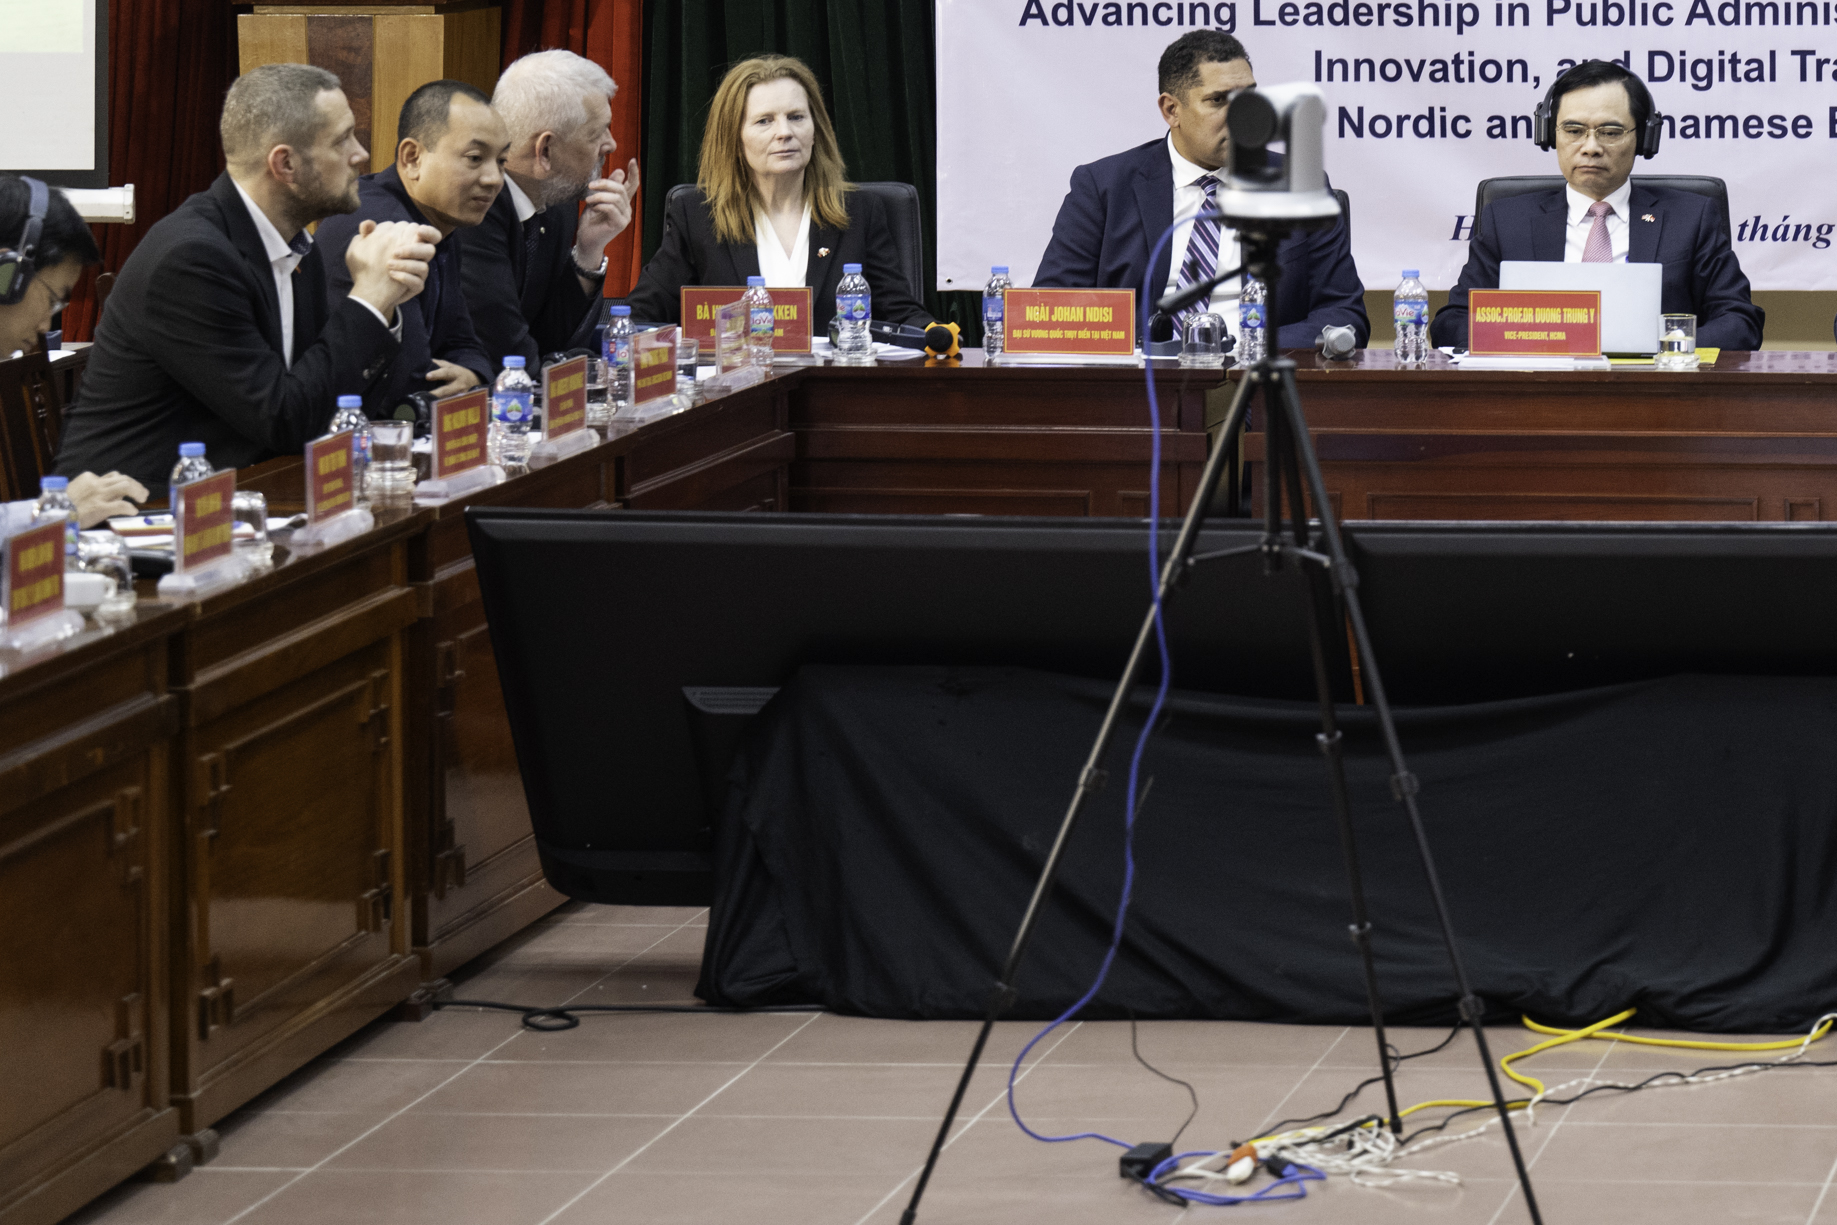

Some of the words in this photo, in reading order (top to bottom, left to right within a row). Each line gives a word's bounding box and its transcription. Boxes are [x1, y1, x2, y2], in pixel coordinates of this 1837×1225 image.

[1314, 49, 1541, 90] Innovation,
[1647, 50, 1777, 92] Digital
[1338, 105, 1473, 139] Nordic
[1486, 114, 1533, 139] an
[1736, 214, 1836, 250] tháng
[696, 301, 710, 320] BÀ
[1025, 303, 1049, 322] NGÀI
[1051, 306, 1084, 322] JOHAN
[1085, 306, 1113, 323] NDISI
[1563, 308, 1588, 324] TRUNG
[1589, 308, 1596, 324] Y
